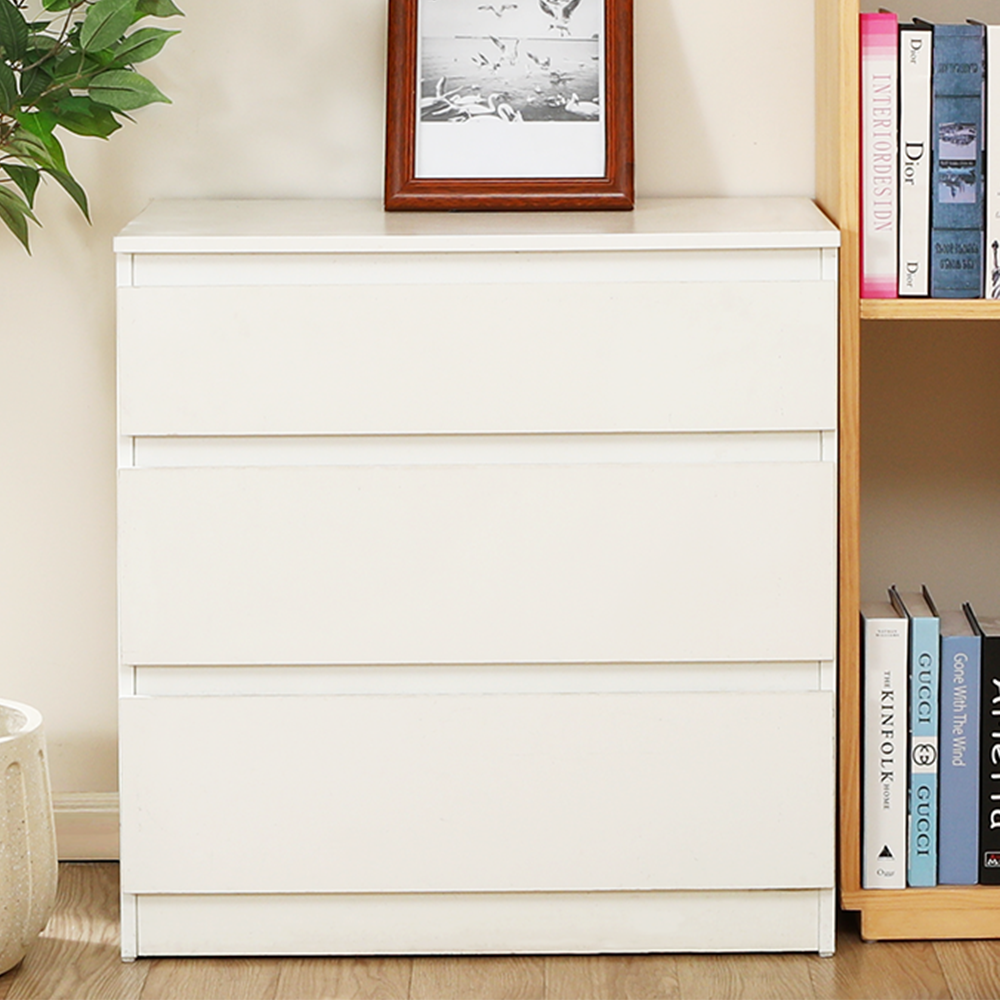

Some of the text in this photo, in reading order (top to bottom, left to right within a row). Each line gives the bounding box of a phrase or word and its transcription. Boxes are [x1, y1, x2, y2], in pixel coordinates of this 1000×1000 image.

[910, 38, 922, 64] Dior
[872, 75, 892, 231] INTERIORDESIDN
[905, 142, 924, 185] Dior
[906, 262, 919, 287] Dior
[918, 653, 932, 723] GUCCI
[952, 652, 968, 766] Gone With The Wind
[881, 690, 894, 782] KINFOLK
[917, 785, 931, 855] GUCCI
